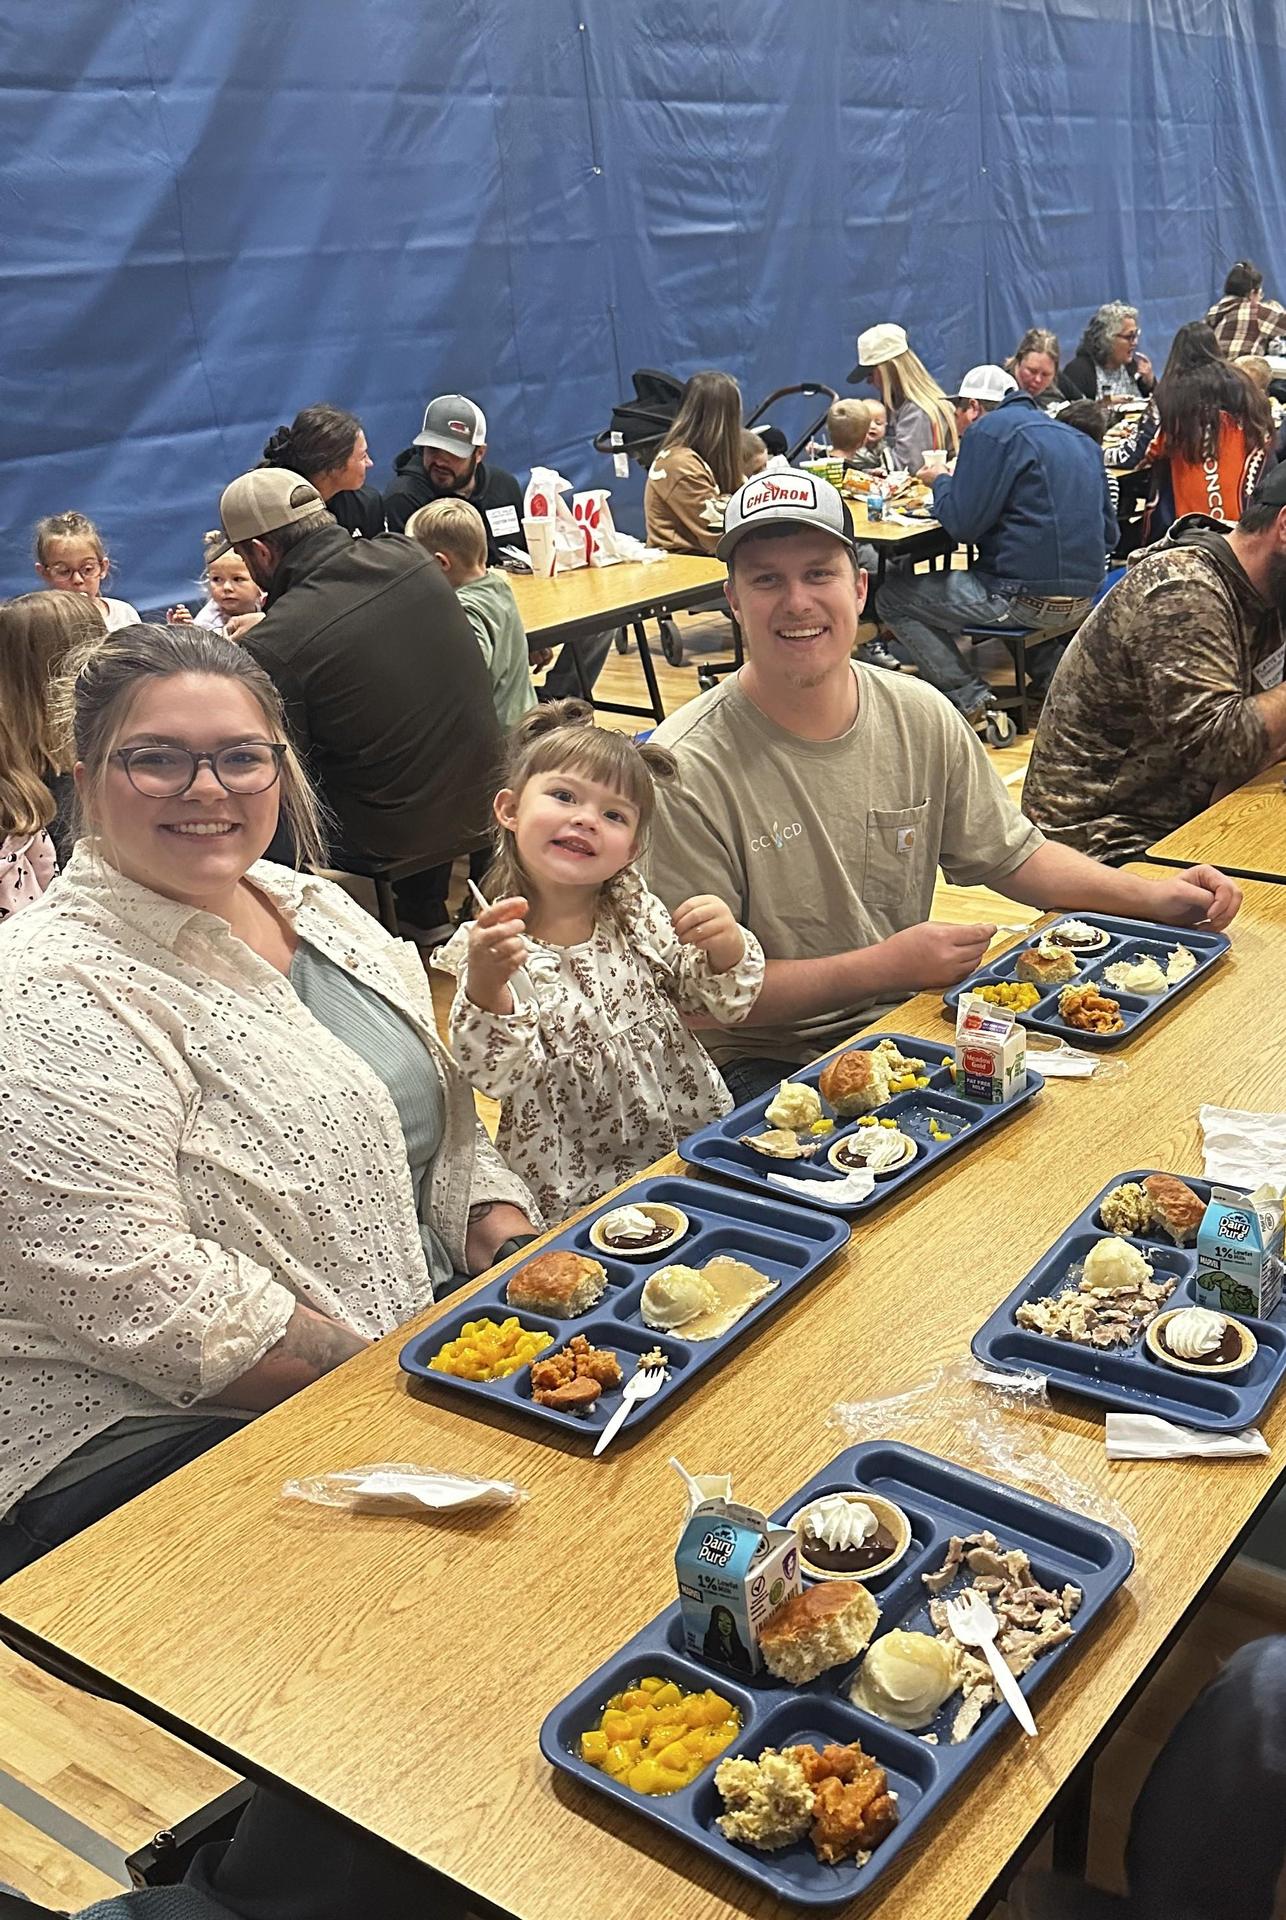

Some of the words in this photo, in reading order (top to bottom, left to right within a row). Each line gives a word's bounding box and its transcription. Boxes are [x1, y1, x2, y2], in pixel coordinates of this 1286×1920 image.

[746, 485, 809, 508] CHEVRON
[1218, 1226, 1245, 1241] Pure
[1220, 1217, 1250, 1235] Dairy
[1215, 1246, 1233, 1259] 1%
[1200, 1255, 1220, 1269] MARVEL
[702, 1533, 735, 1557] Dairy
[698, 1546, 728, 1567] Pure
[698, 1574, 718, 1591] 1%
[680, 1584, 702, 1601] MARVEL
